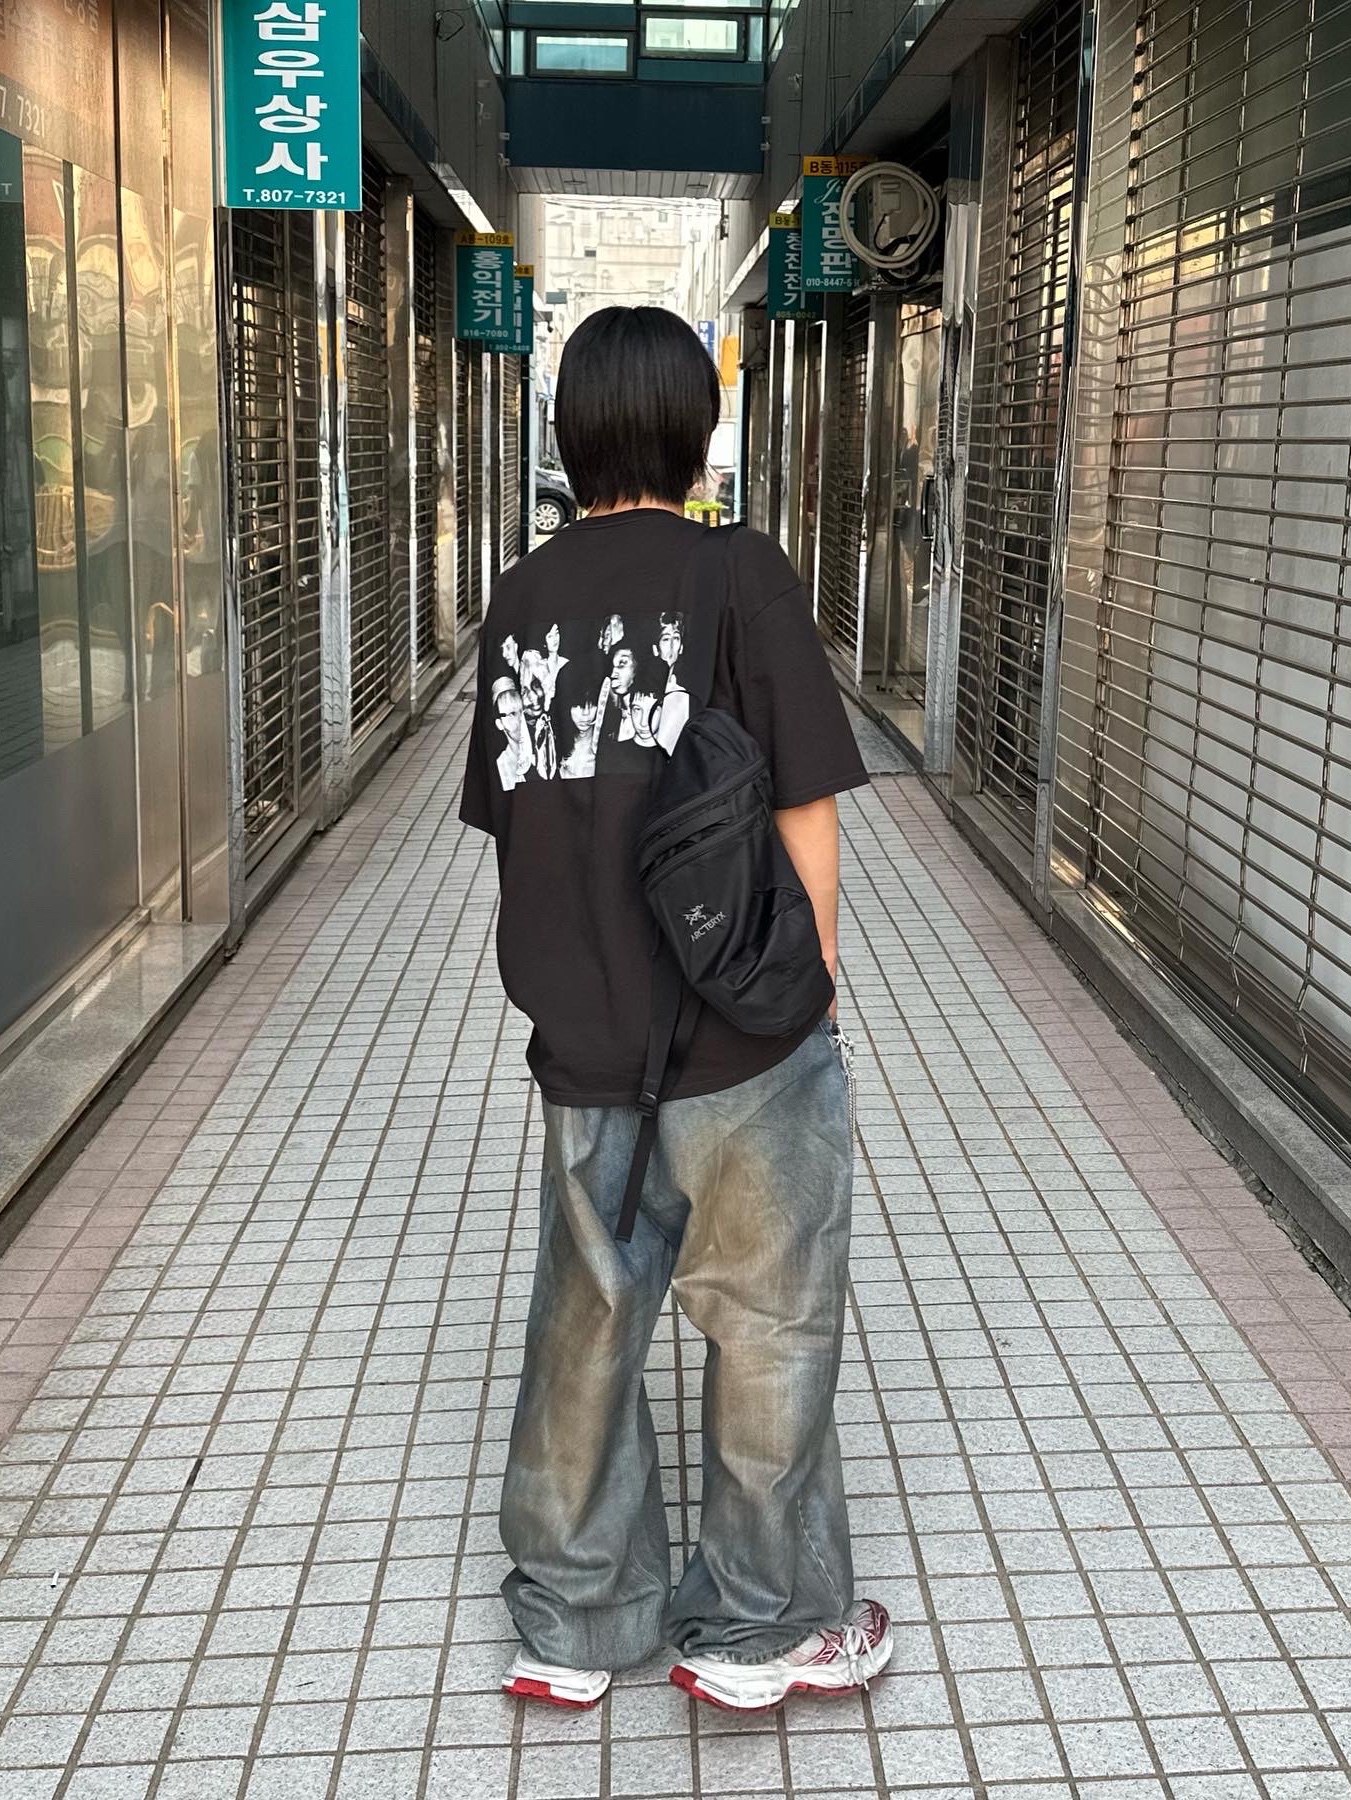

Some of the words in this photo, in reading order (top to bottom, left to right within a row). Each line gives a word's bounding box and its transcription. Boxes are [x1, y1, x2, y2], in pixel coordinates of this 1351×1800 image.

[253, 2, 329, 181] 삼우상사
[17, 94, 45, 138] 7321
[242, 188, 346, 205] T.807-7321
